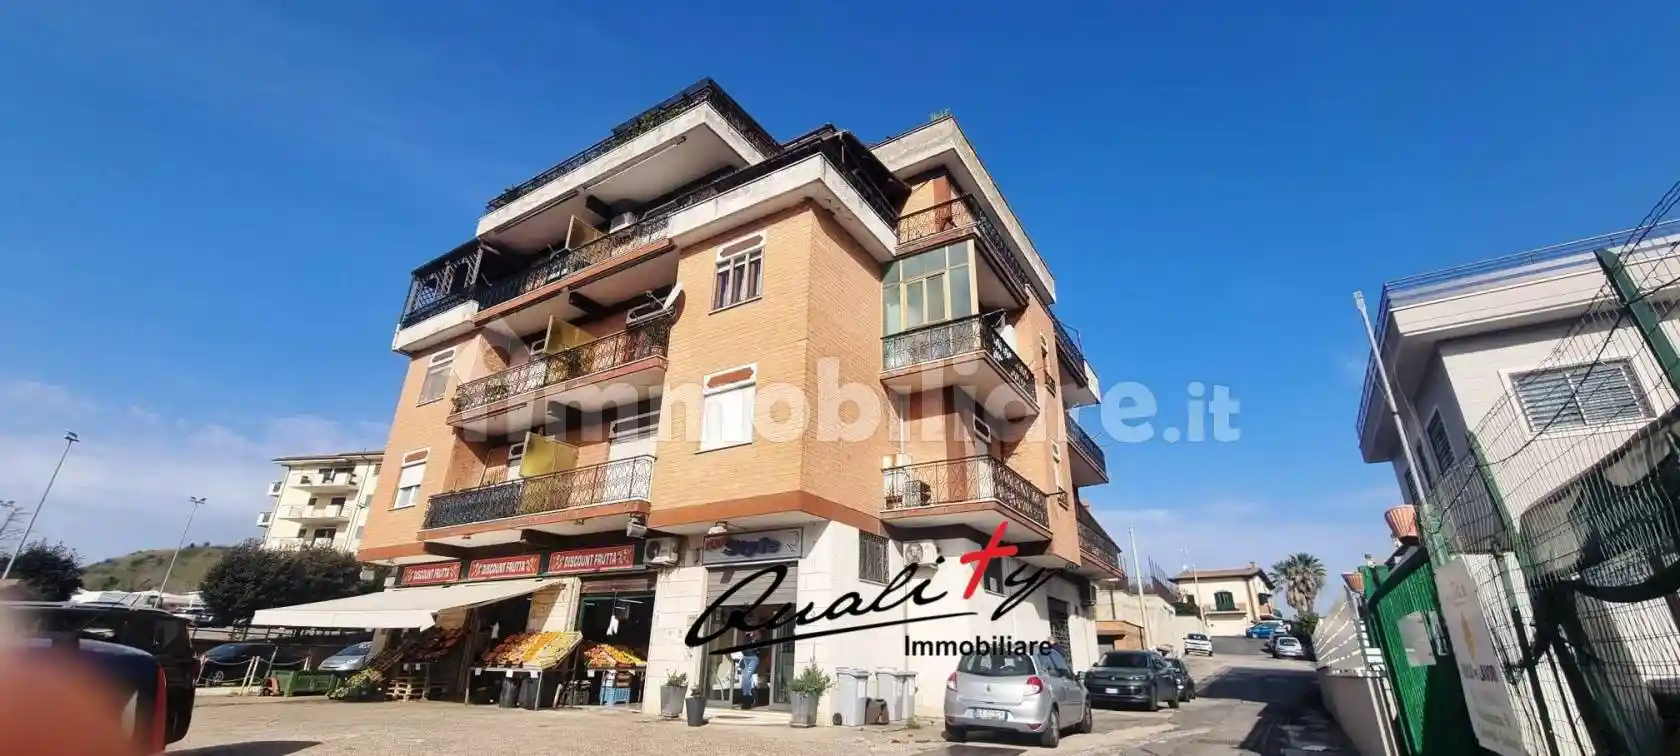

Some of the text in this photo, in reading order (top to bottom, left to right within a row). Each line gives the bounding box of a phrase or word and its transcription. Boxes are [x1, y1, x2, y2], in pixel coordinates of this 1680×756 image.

[482, 559, 526, 575] DISCOUNT FRUTTA
[563, 551, 617, 569] DISCOUNT FRUTTA
[413, 566, 450, 580] DISCOUNT FRUTTA
